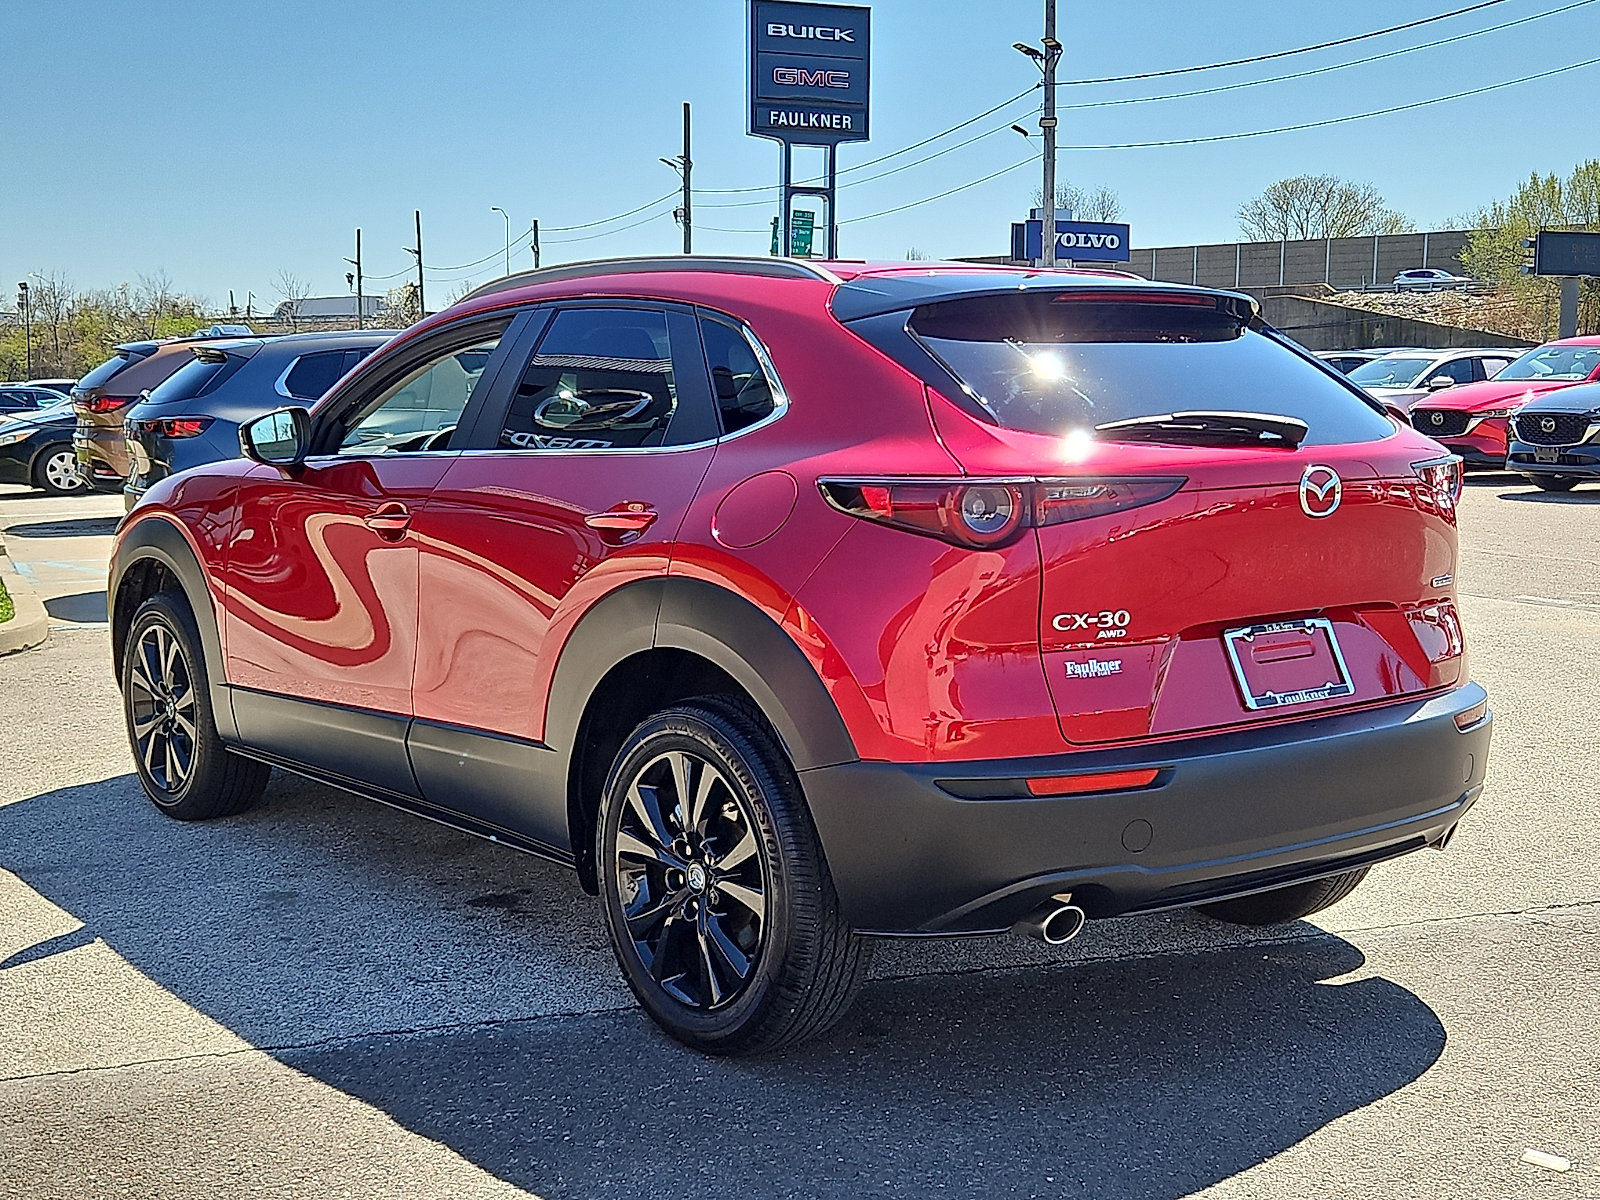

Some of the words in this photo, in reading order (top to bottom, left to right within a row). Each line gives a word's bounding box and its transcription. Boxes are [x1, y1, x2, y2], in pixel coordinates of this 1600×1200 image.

[767, 23, 856, 42] BUICK
[773, 67, 849, 88] GMC
[770, 110, 852, 129] FAULKNER
[1052, 609, 1131, 631] CX-30
[1096, 628, 1127, 639] AWD
[1064, 659, 1122, 675] Faulkner
[1276, 690, 1331, 704] Faulkner
